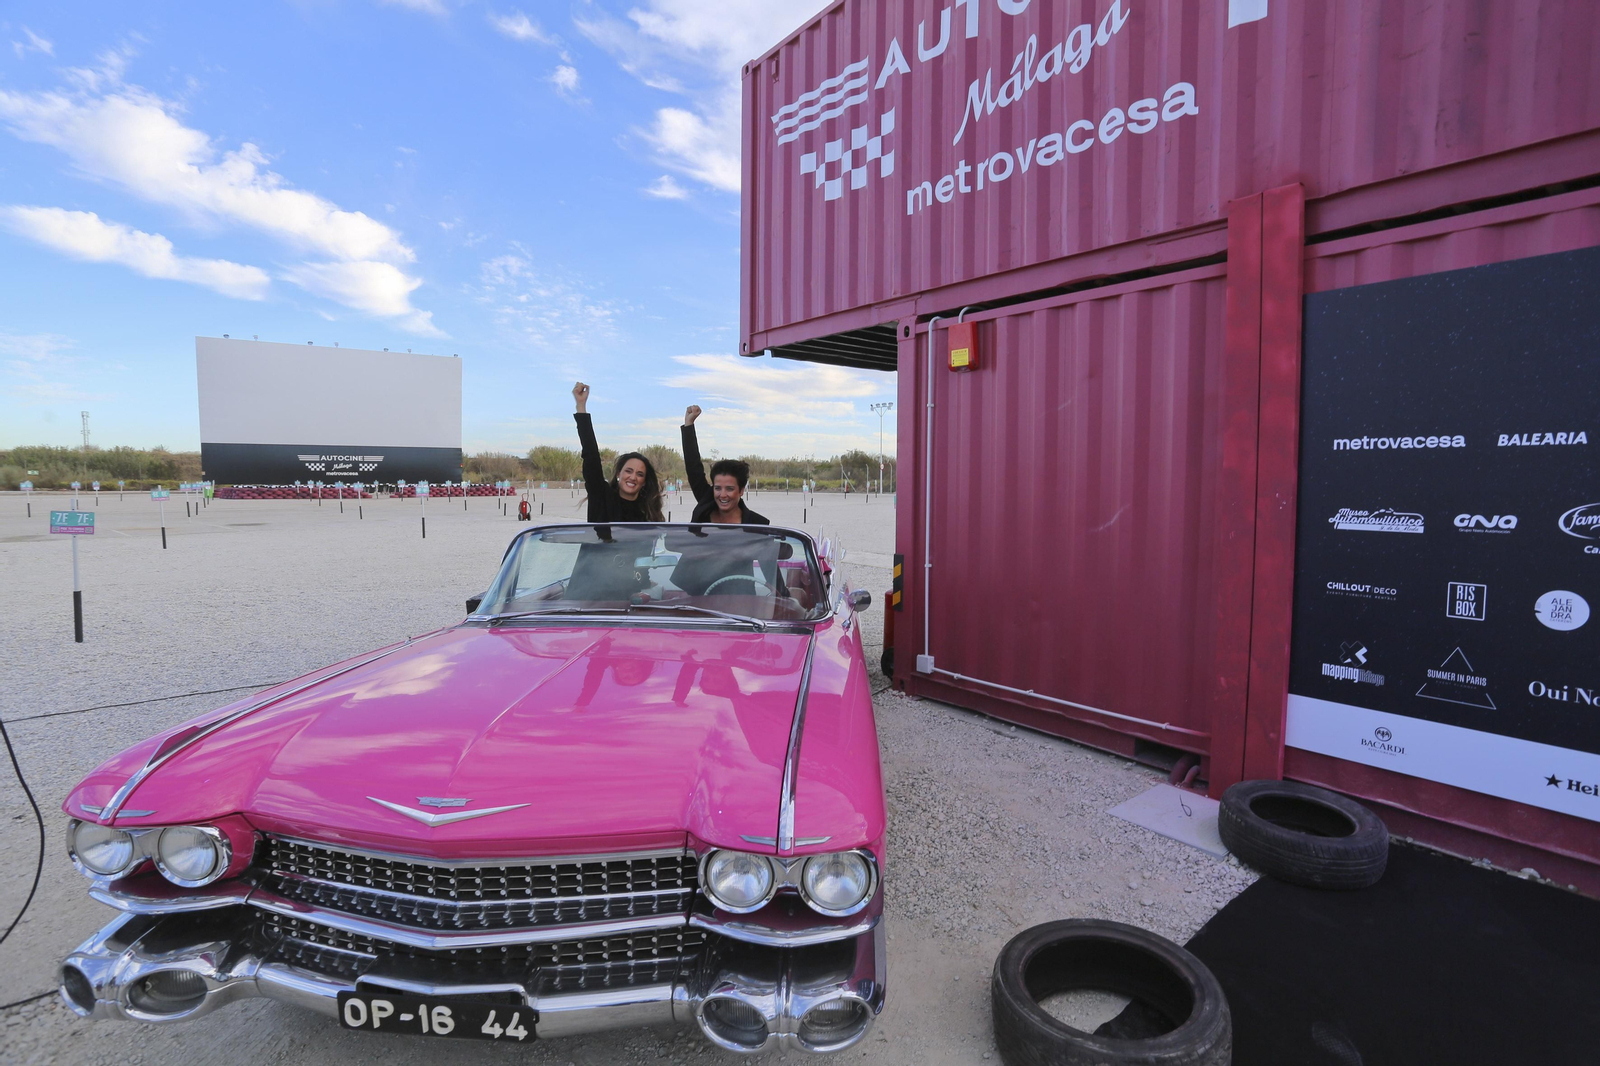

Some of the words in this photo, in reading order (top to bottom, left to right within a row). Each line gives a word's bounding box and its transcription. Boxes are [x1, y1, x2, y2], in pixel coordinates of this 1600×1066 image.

[953, 0, 1131, 146] Málaga
[907, 81, 1199, 216] metrovacesa
[1333, 435, 1466, 450] metrovacesa
[55, 512, 69, 523] 7F
[76, 513, 90, 523] 7F
[1339, 508, 1369, 516] Museo
[1584, 545, 1600, 554] Ca
[1326, 581, 1371, 593] CHILLOUT
[1373, 586, 1397, 596] DECO
[1456, 585, 1475, 601] RIS
[1455, 600, 1476, 617] BOX
[1551, 597, 1573, 606] ALE
[1551, 604, 1573, 613] JAN
[1550, 611, 1572, 620] DRA
[1427, 668, 1456, 682] SUMMER
[1456, 673, 1465, 683] IN
[1466, 675, 1487, 687] PARIS
[1528, 680, 1569, 702] Oui
[1360, 738, 1405, 755] BACARDI
[343, 997, 456, 1036] OP-16
[481, 1009, 529, 1042] 44
